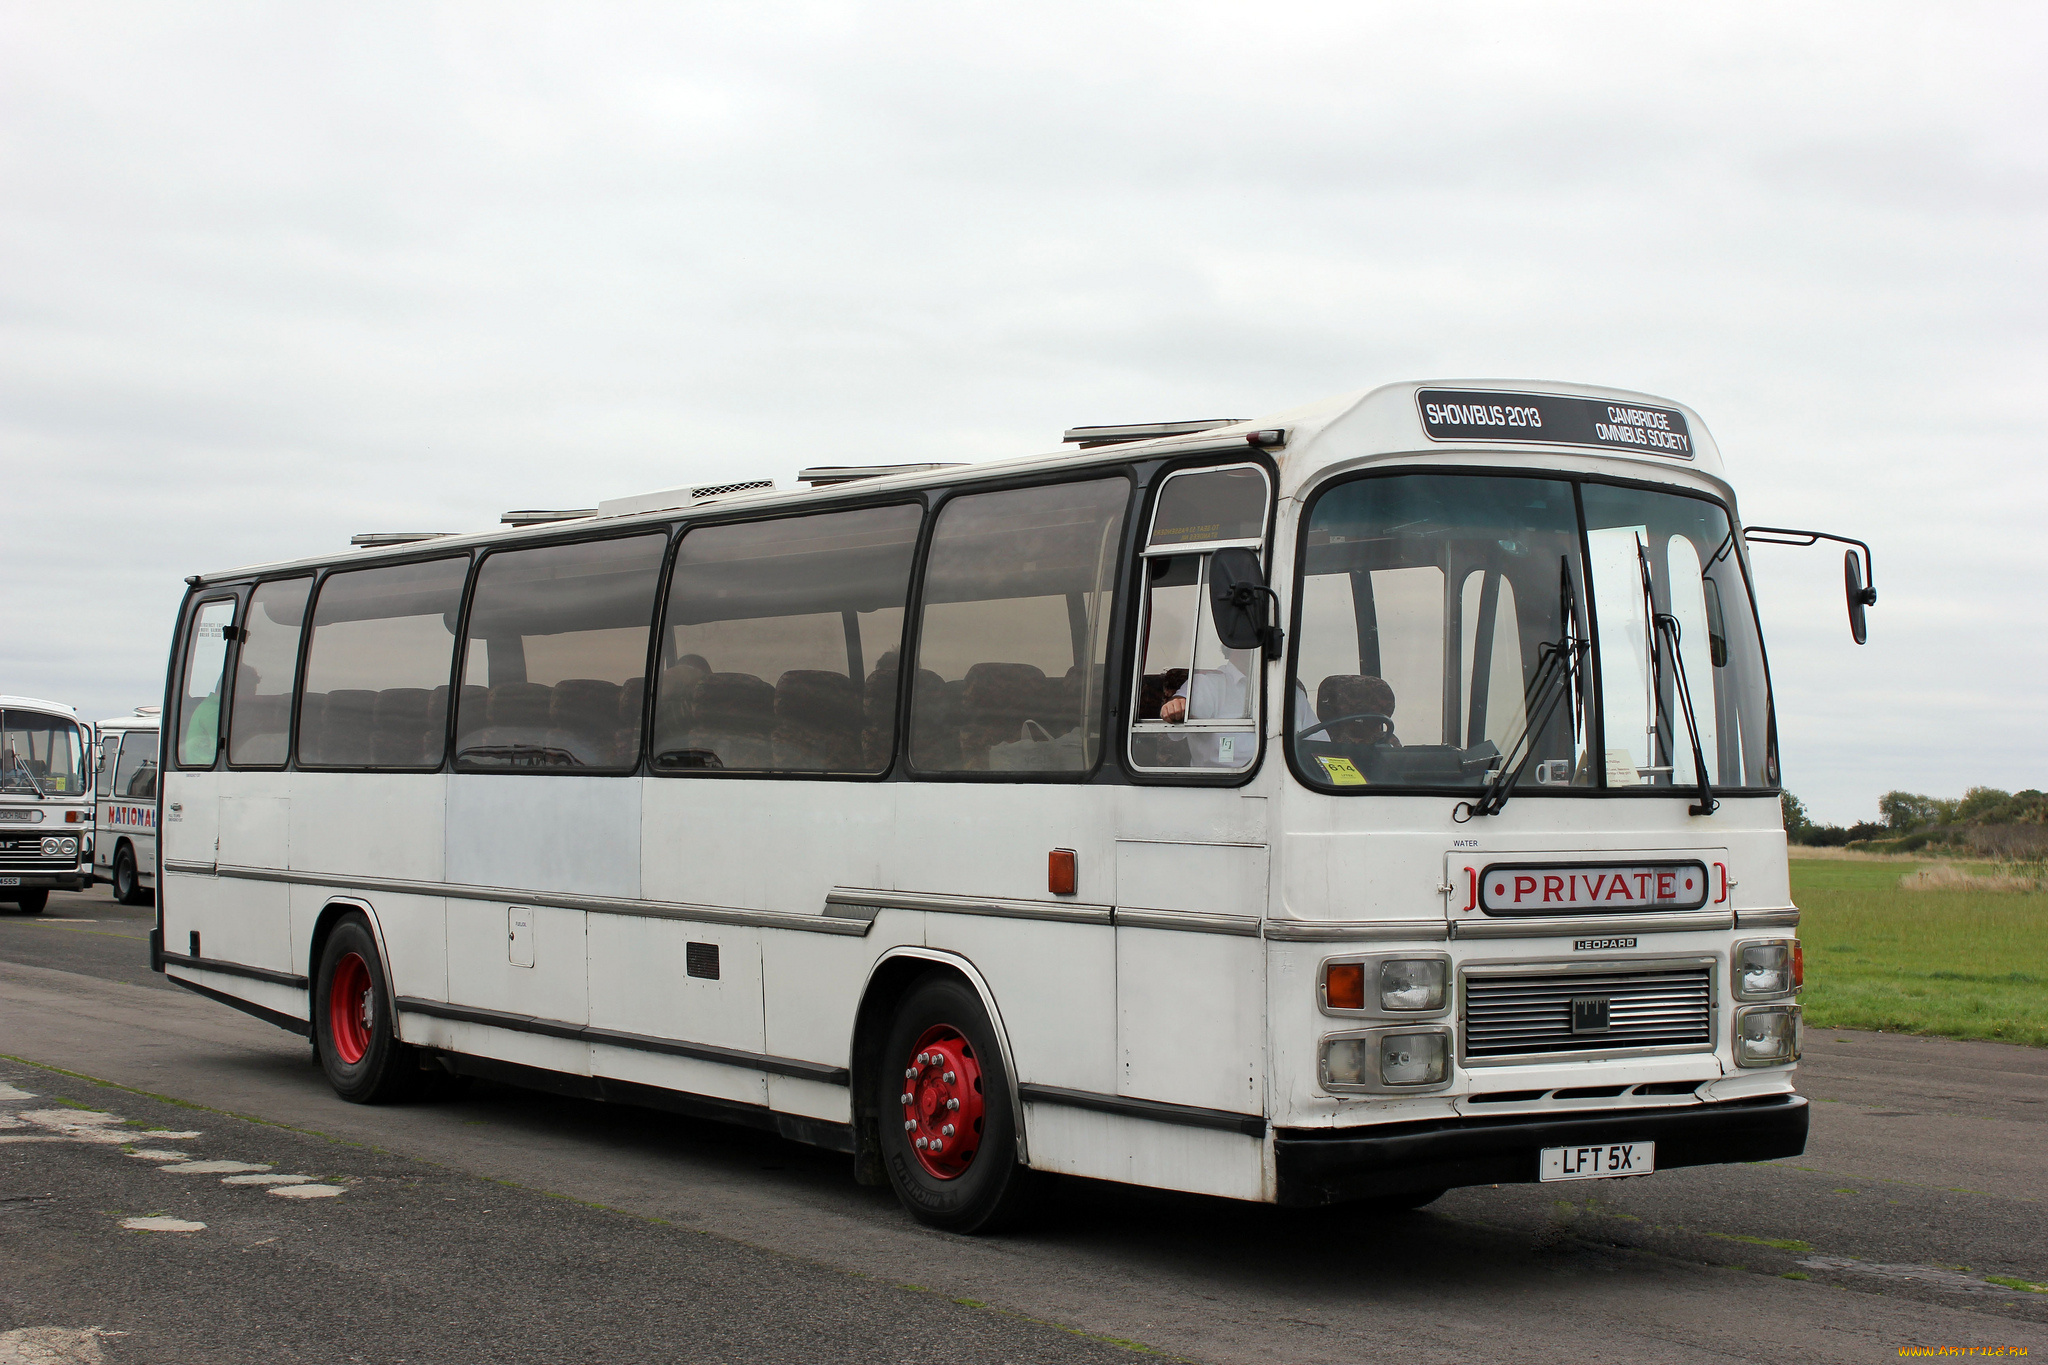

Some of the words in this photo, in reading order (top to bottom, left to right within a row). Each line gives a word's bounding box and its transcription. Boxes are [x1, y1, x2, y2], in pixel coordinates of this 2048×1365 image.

[1426, 403, 1506, 426] SHOWBUS
[1505, 406, 1542, 428] 2013
[1607, 406, 1671, 431] CAMBRIDGE
[1595, 423, 1648, 445] OMNIBUS
[1646, 429, 1689, 452] SOCIETY
[1328, 763, 1356, 771] 614
[108, 806, 156, 827] NATIONAL
[1453, 839, 1479, 847] WATER
[1513, 872, 1677, 903] PRIVATE
[1577, 938, 1635, 950] LEOPARD
[1563, 1147, 1603, 1174] LFT
[1608, 1145, 1633, 1171] 5X
[892, 1157, 942, 1208] MICHELIN
